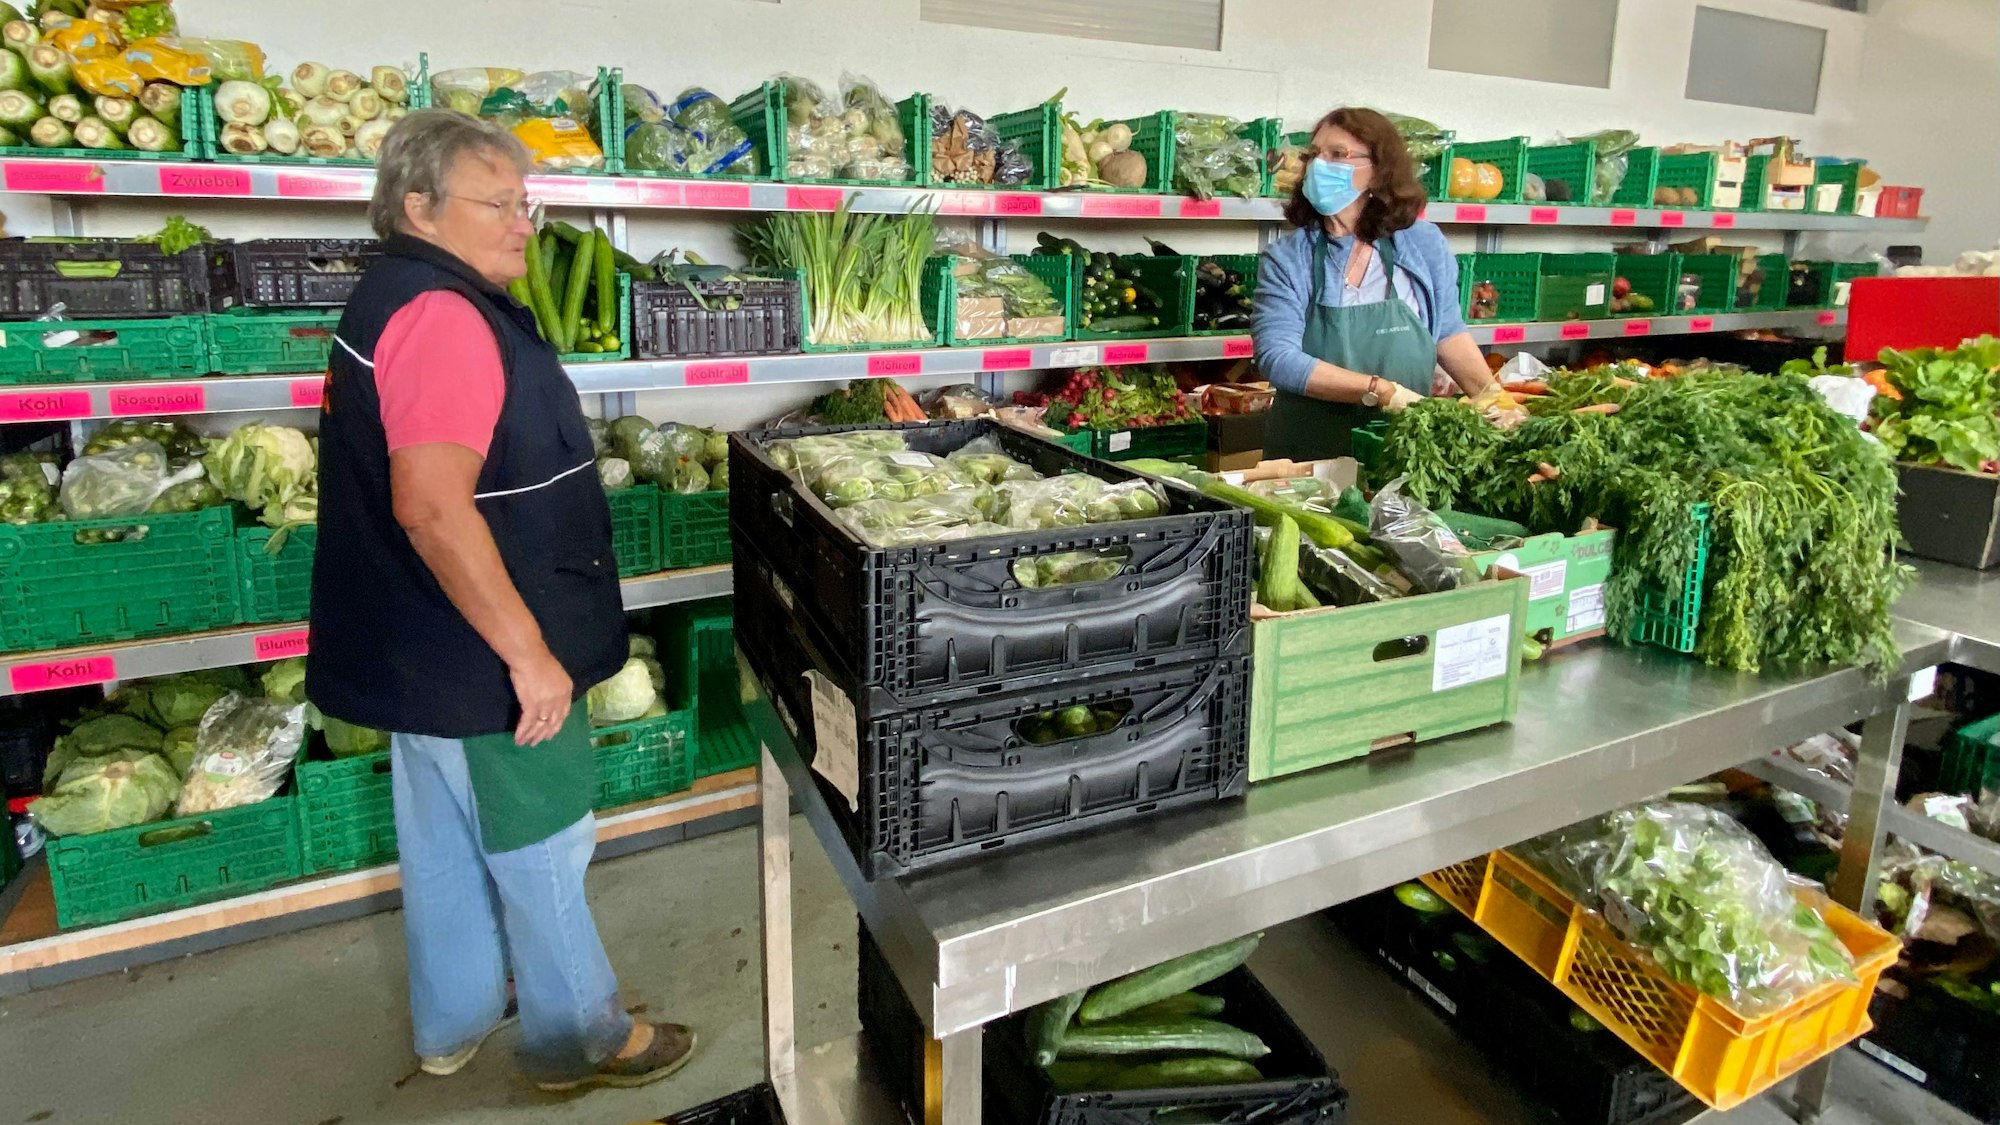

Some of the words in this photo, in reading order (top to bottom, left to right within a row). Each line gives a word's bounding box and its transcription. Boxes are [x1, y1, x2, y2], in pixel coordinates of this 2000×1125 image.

[171, 174, 240, 188] Zwiebel
[1001, 199, 1037, 211] Spargel
[874, 361, 916, 371] Möhren
[690, 367, 743, 381] Kohlrabi
[299, 387, 322, 396] Blu
[19, 397, 64, 411] Kohl
[117, 394, 199, 407] Rosenkohl
[47, 661, 93, 678] Kohl
